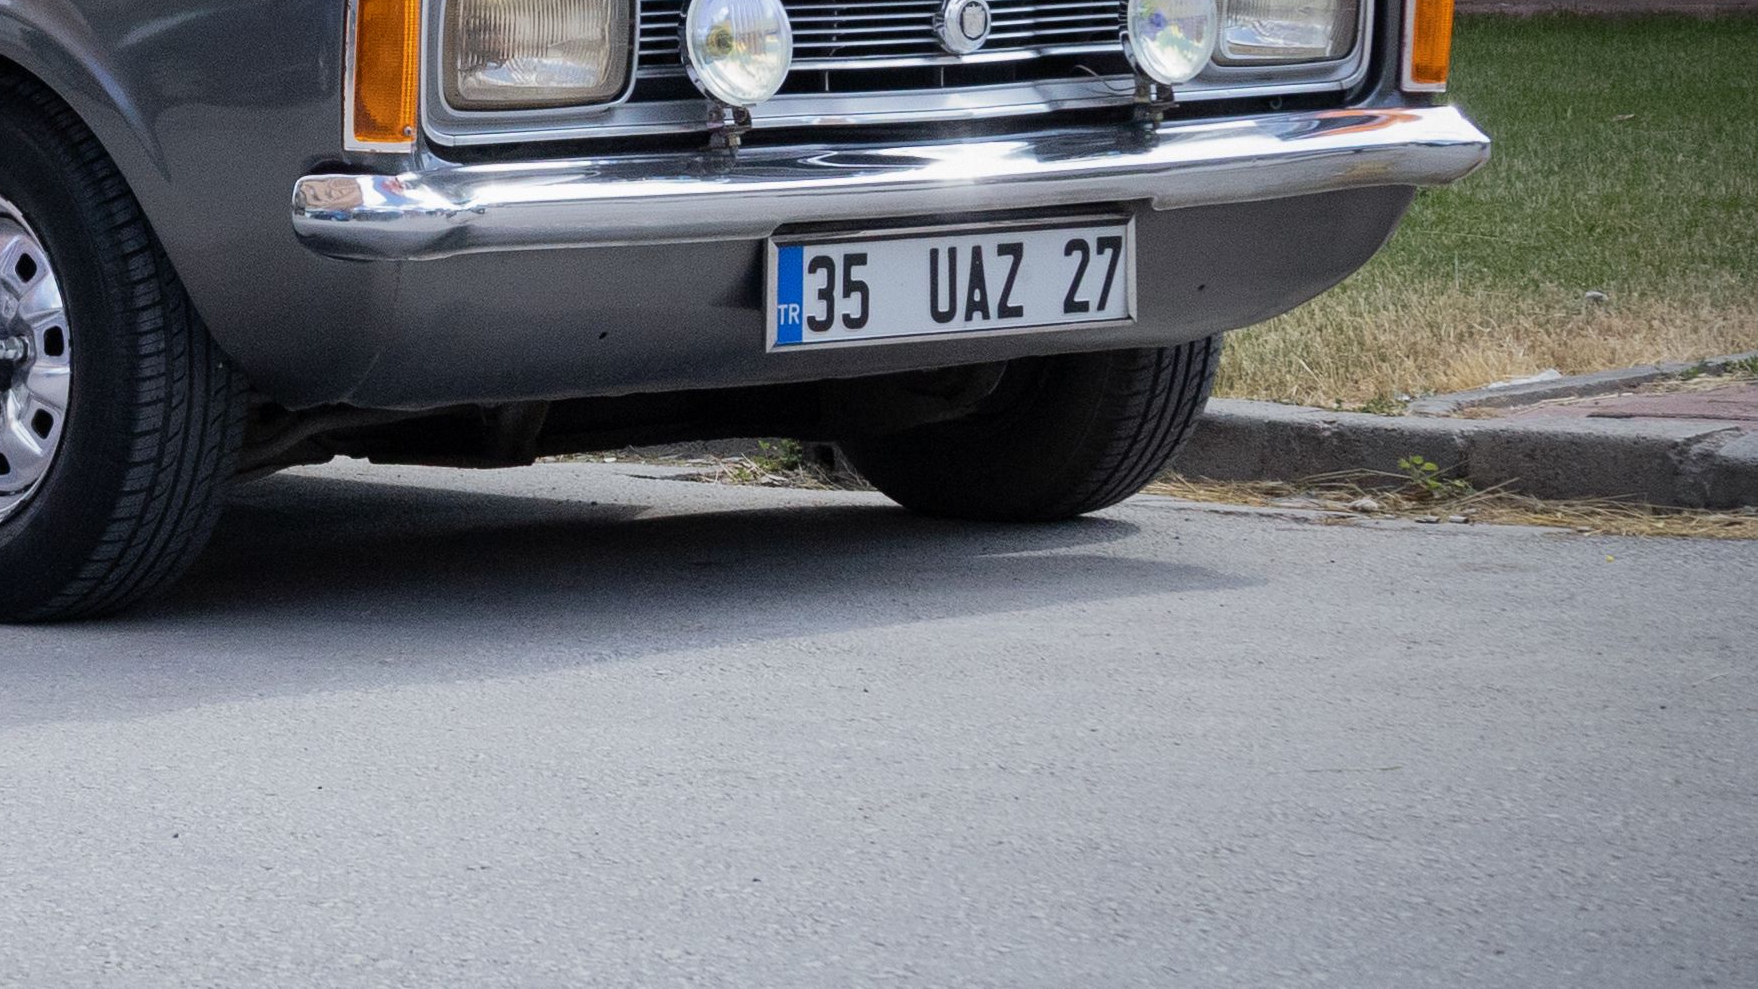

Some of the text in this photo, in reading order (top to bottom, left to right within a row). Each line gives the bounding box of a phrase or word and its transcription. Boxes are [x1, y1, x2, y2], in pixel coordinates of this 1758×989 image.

[777, 236, 1123, 332] TR 35 UAZ 27
